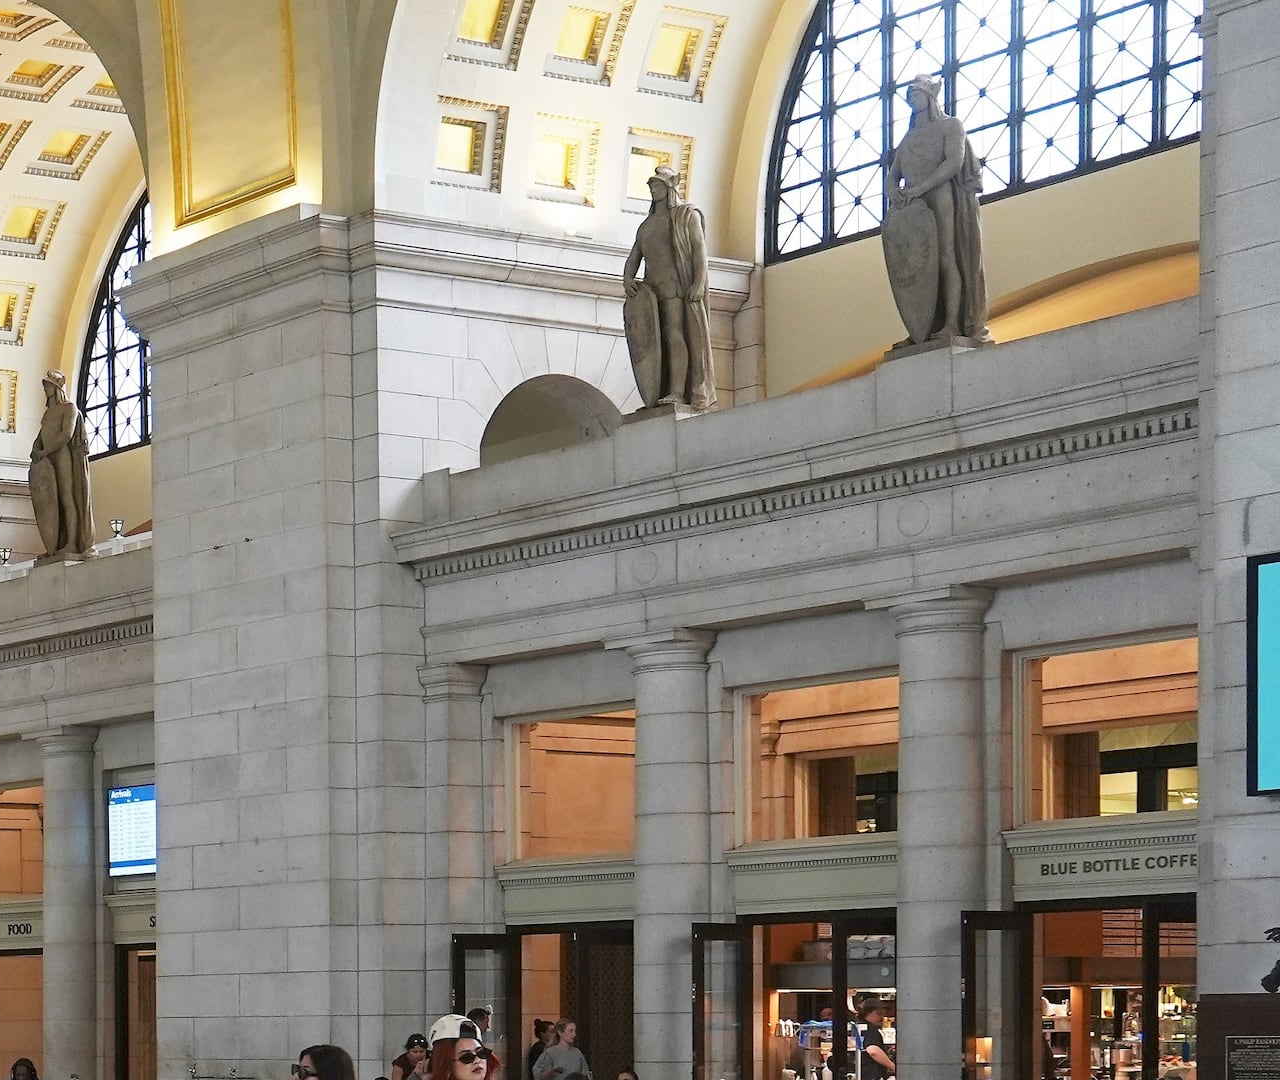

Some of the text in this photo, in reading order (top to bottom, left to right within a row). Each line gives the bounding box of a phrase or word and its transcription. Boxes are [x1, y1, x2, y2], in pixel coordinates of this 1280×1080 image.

[1040, 861, 1078, 876] BLUE
[1083, 858, 1141, 873] BOTTLE
[7, 923, 32, 936] FOOD
